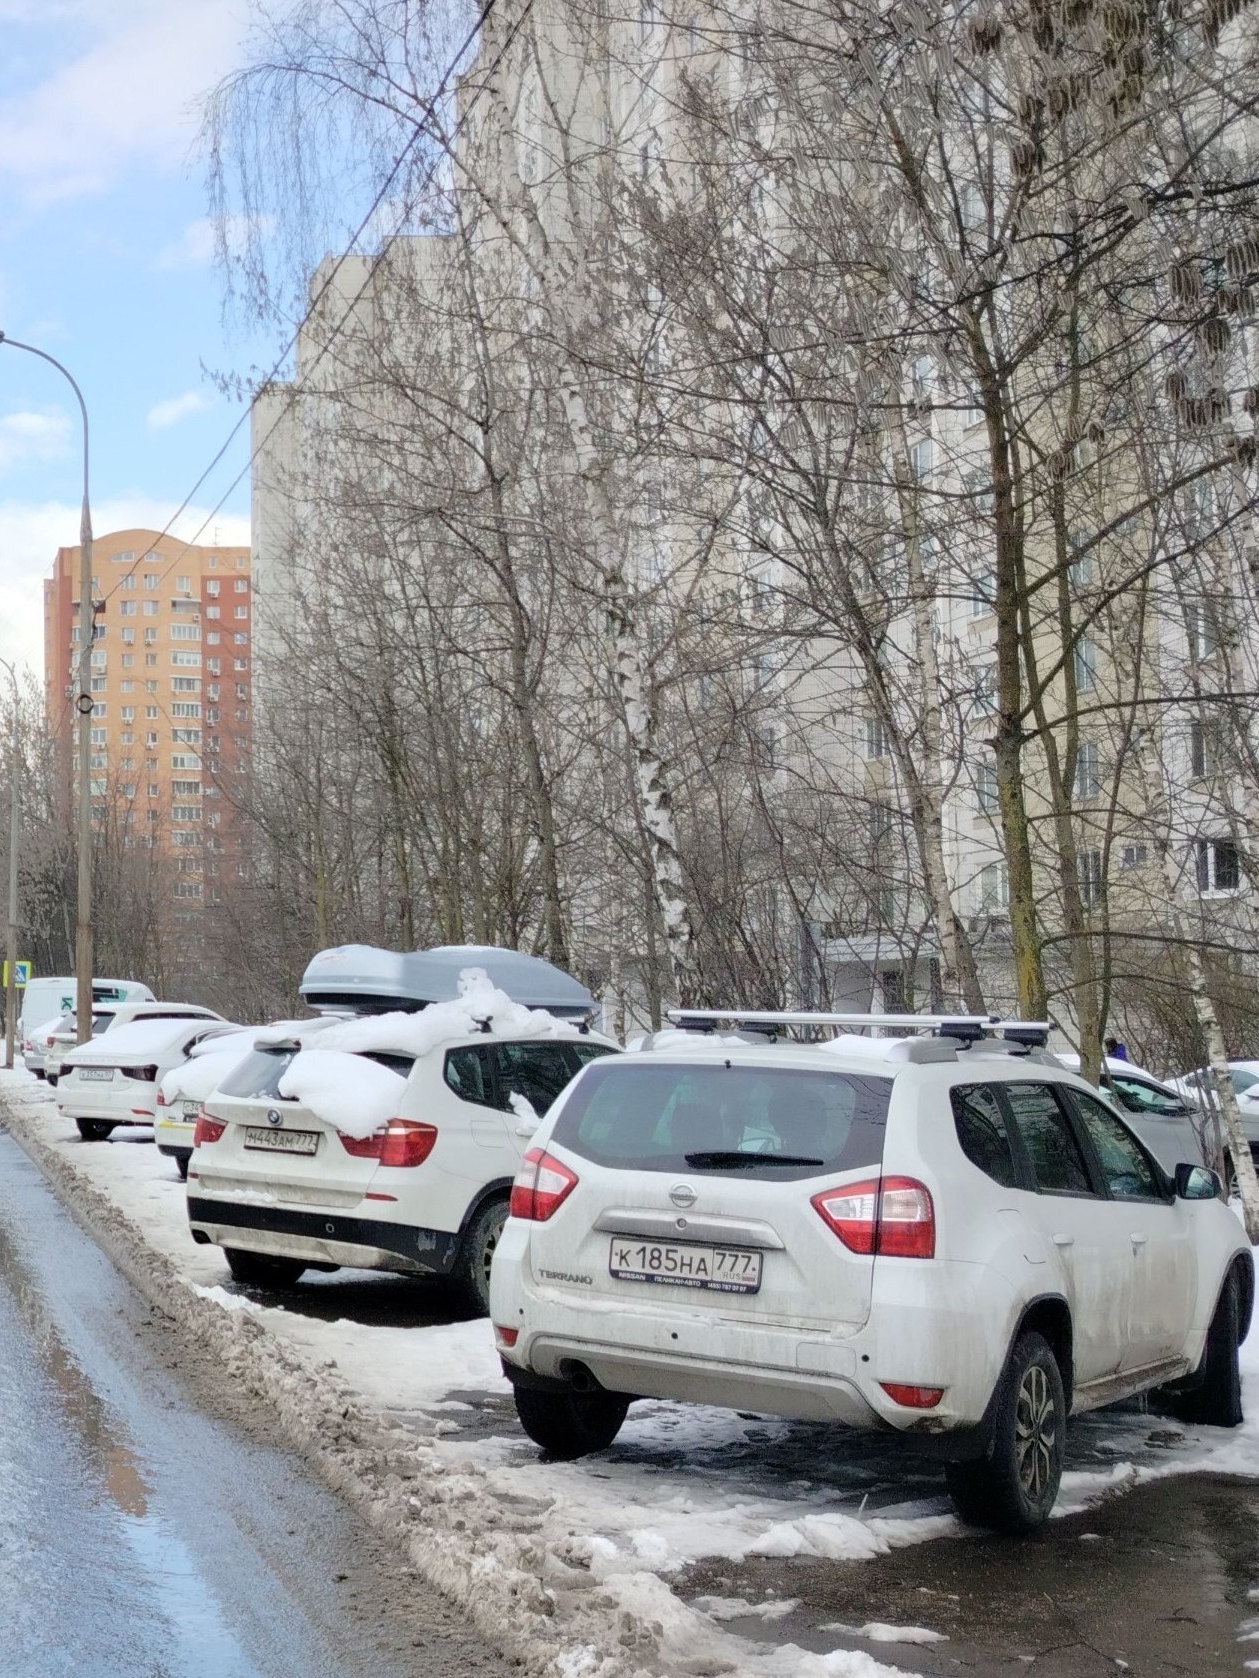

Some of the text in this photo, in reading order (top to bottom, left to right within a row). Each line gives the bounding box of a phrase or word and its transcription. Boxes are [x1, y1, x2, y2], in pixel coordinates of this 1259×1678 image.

[248, 1131, 294, 1148] М443АМ
[618, 1246, 752, 1276] К185НА 777
[538, 1269, 593, 1285] TERRANO
[618, 1272, 646, 1281] NISSAN
[723, 1271, 741, 1281] RUS
